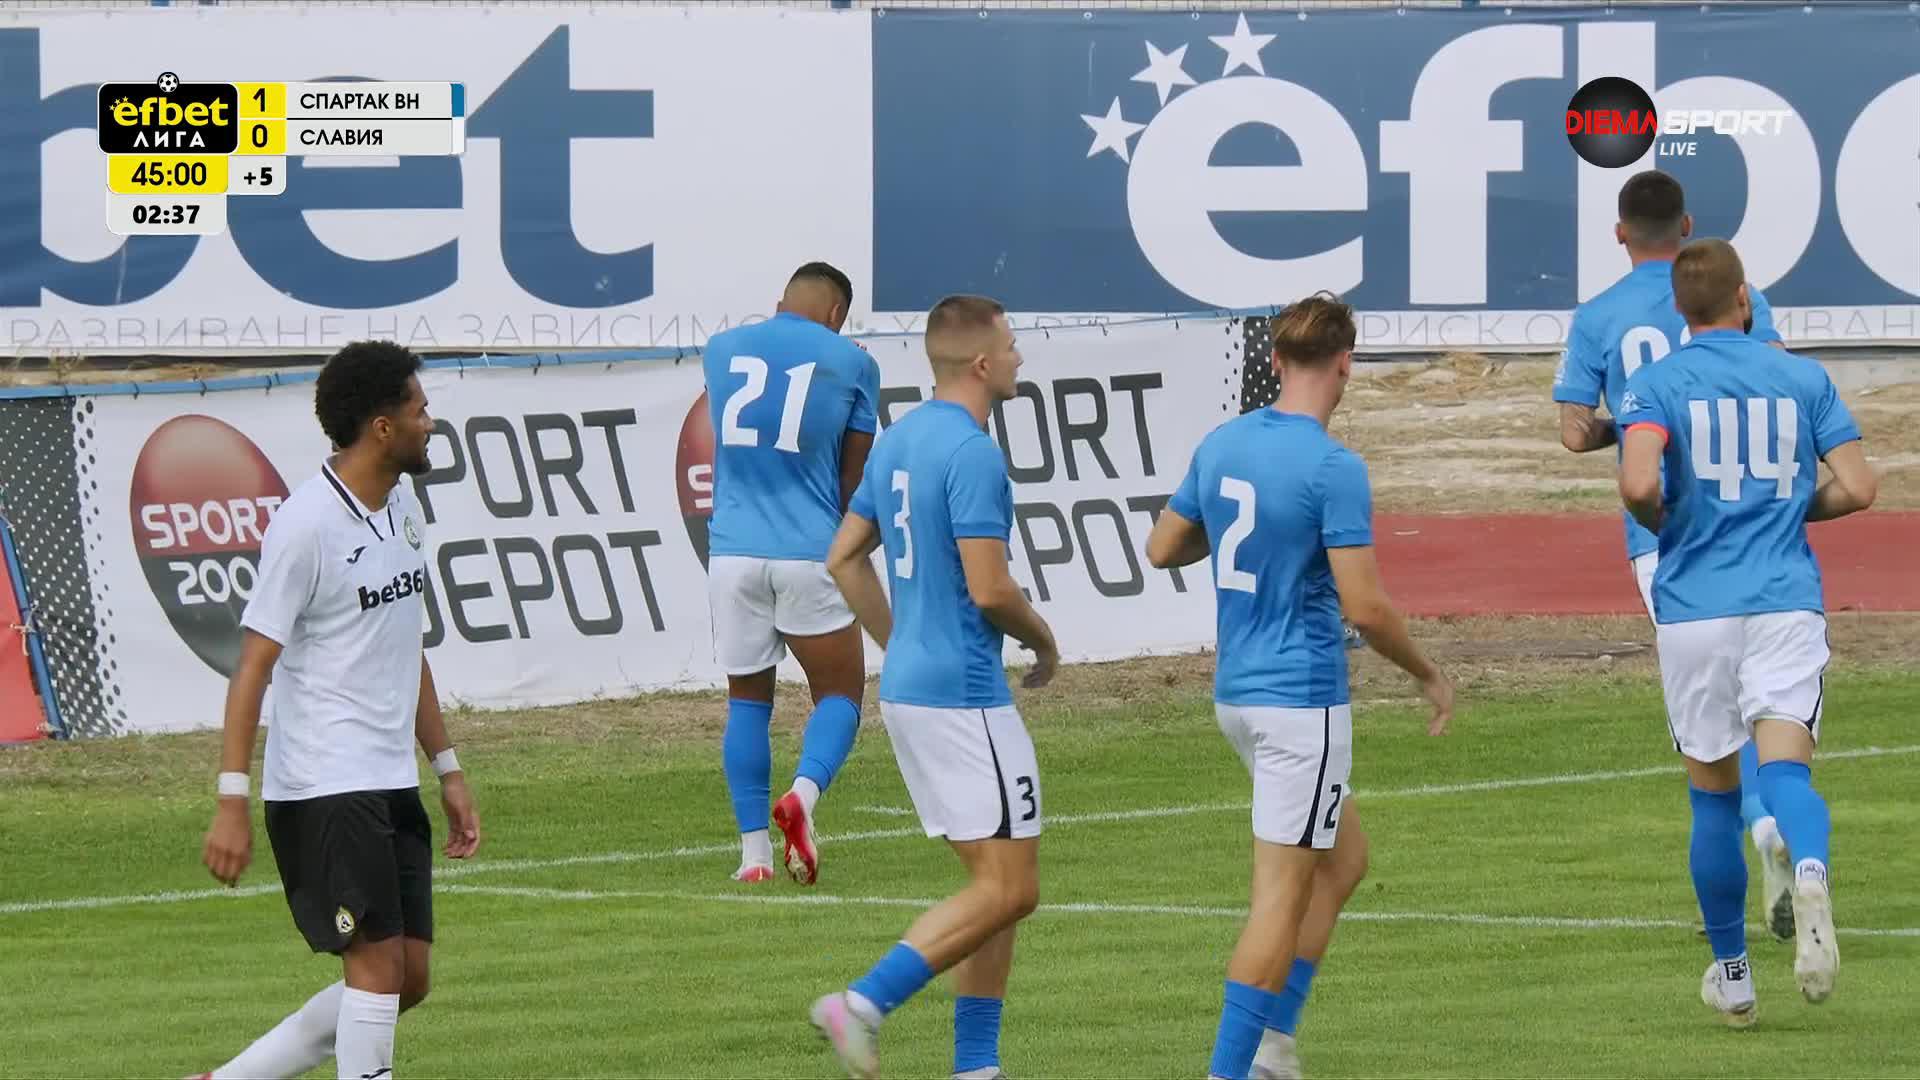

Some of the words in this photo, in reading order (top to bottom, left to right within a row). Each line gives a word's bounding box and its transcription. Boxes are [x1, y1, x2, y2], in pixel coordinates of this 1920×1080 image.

[367, 314, 438, 346] НА
[721, 355, 816, 453] 21
[1689, 397, 1800, 501] 44
[414, 408, 637, 524] PORT
[891, 469, 914, 579] 3
[1216, 476, 1257, 594] 2
[1016, 775, 1036, 820] 3
[1323, 783, 1342, 829] 2
